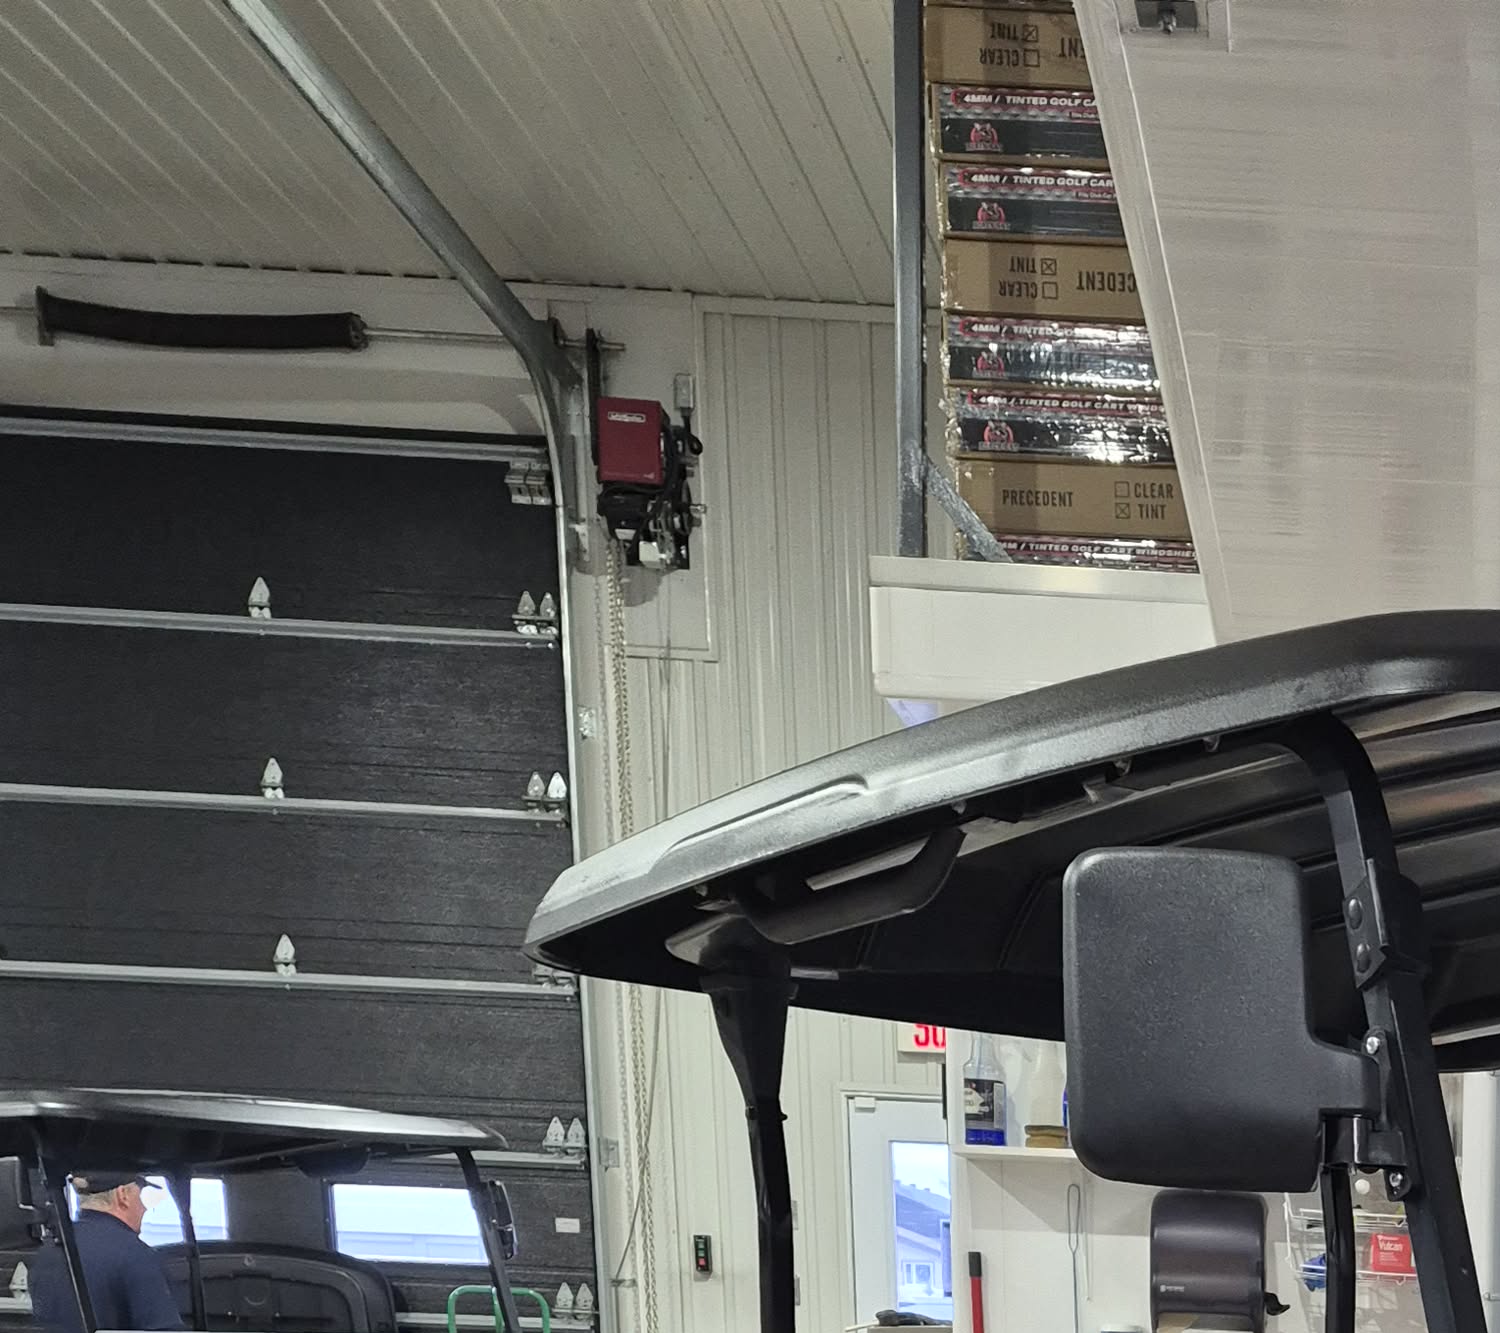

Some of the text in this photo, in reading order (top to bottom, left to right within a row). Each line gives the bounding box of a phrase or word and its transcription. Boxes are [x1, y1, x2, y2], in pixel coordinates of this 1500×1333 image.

[990, 23, 1019, 40] TINT
[979, 47, 1019, 67] CLEAR
[1006, 95, 1048, 105] TINTED
[1049, 96, 1082, 106] GOLF
[971, 174, 1000, 183] 4MM
[1013, 175, 1055, 185] TINTED
[1057, 176, 1089, 186] GOLF
[1009, 256, 1037, 274] TINT
[998, 279, 1038, 299] CLEAR
[971, 323, 999, 334] 4MM
[1020, 398, 1059, 407] TINTED
[1061, 399, 1091, 409] GOLF
[1094, 400, 1124, 410] CART
[1002, 489, 1073, 508] PRECEDENT
[1134, 482, 1174, 499] CLEAR
[1138, 503, 1167, 520] TINT
[1028, 543, 1069, 552] TINTED
[1071, 544, 1100, 553] GOLF
[1103, 545, 1132, 555] CART
